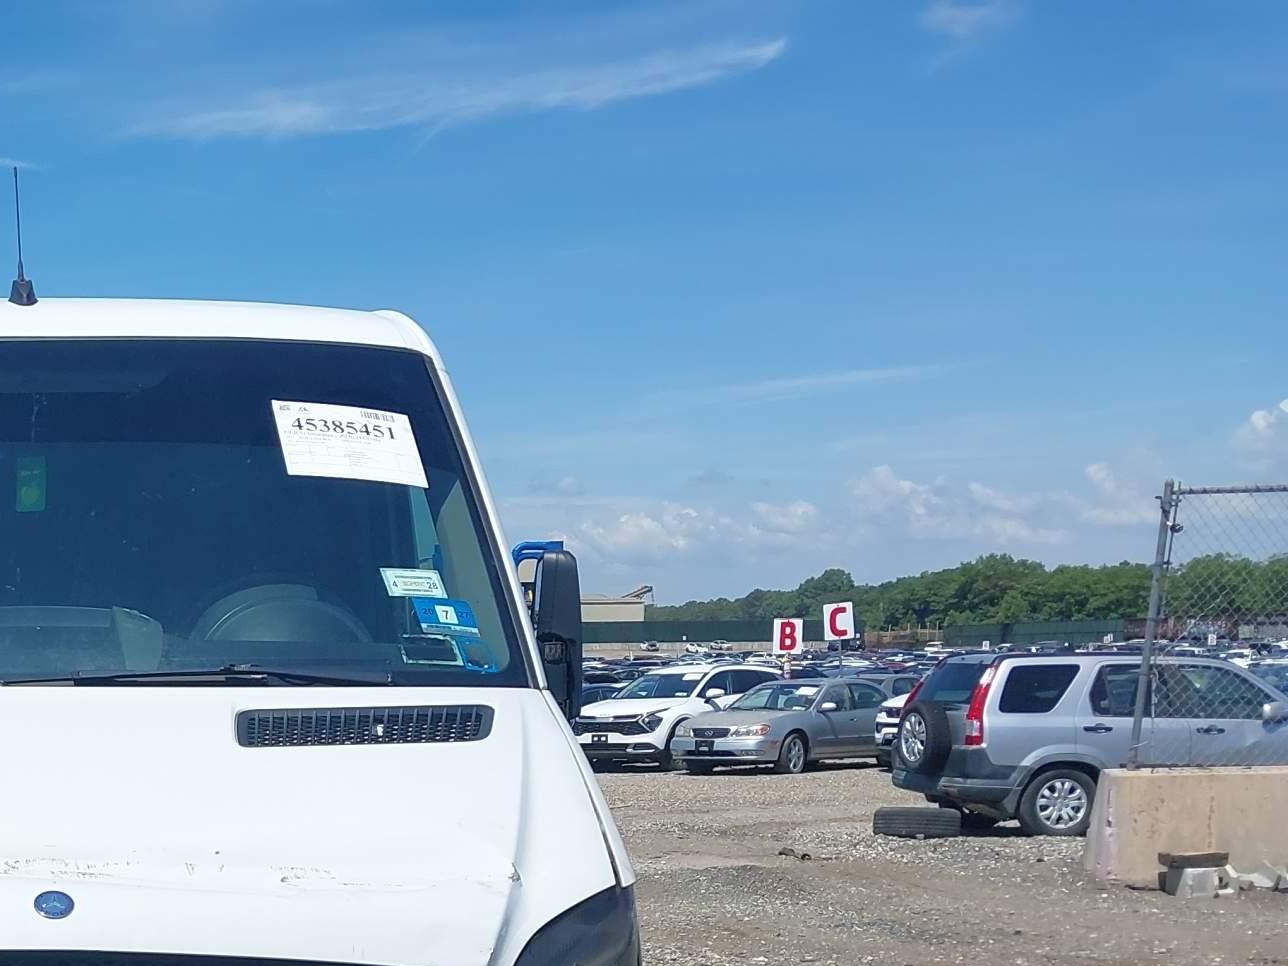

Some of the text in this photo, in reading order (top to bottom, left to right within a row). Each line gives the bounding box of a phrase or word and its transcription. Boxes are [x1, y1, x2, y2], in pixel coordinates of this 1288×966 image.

[291, 417, 396, 440] 45385451
[441, 609, 449, 620] 7
[829, 606, 848, 637] C
[779, 621, 797, 651] B
